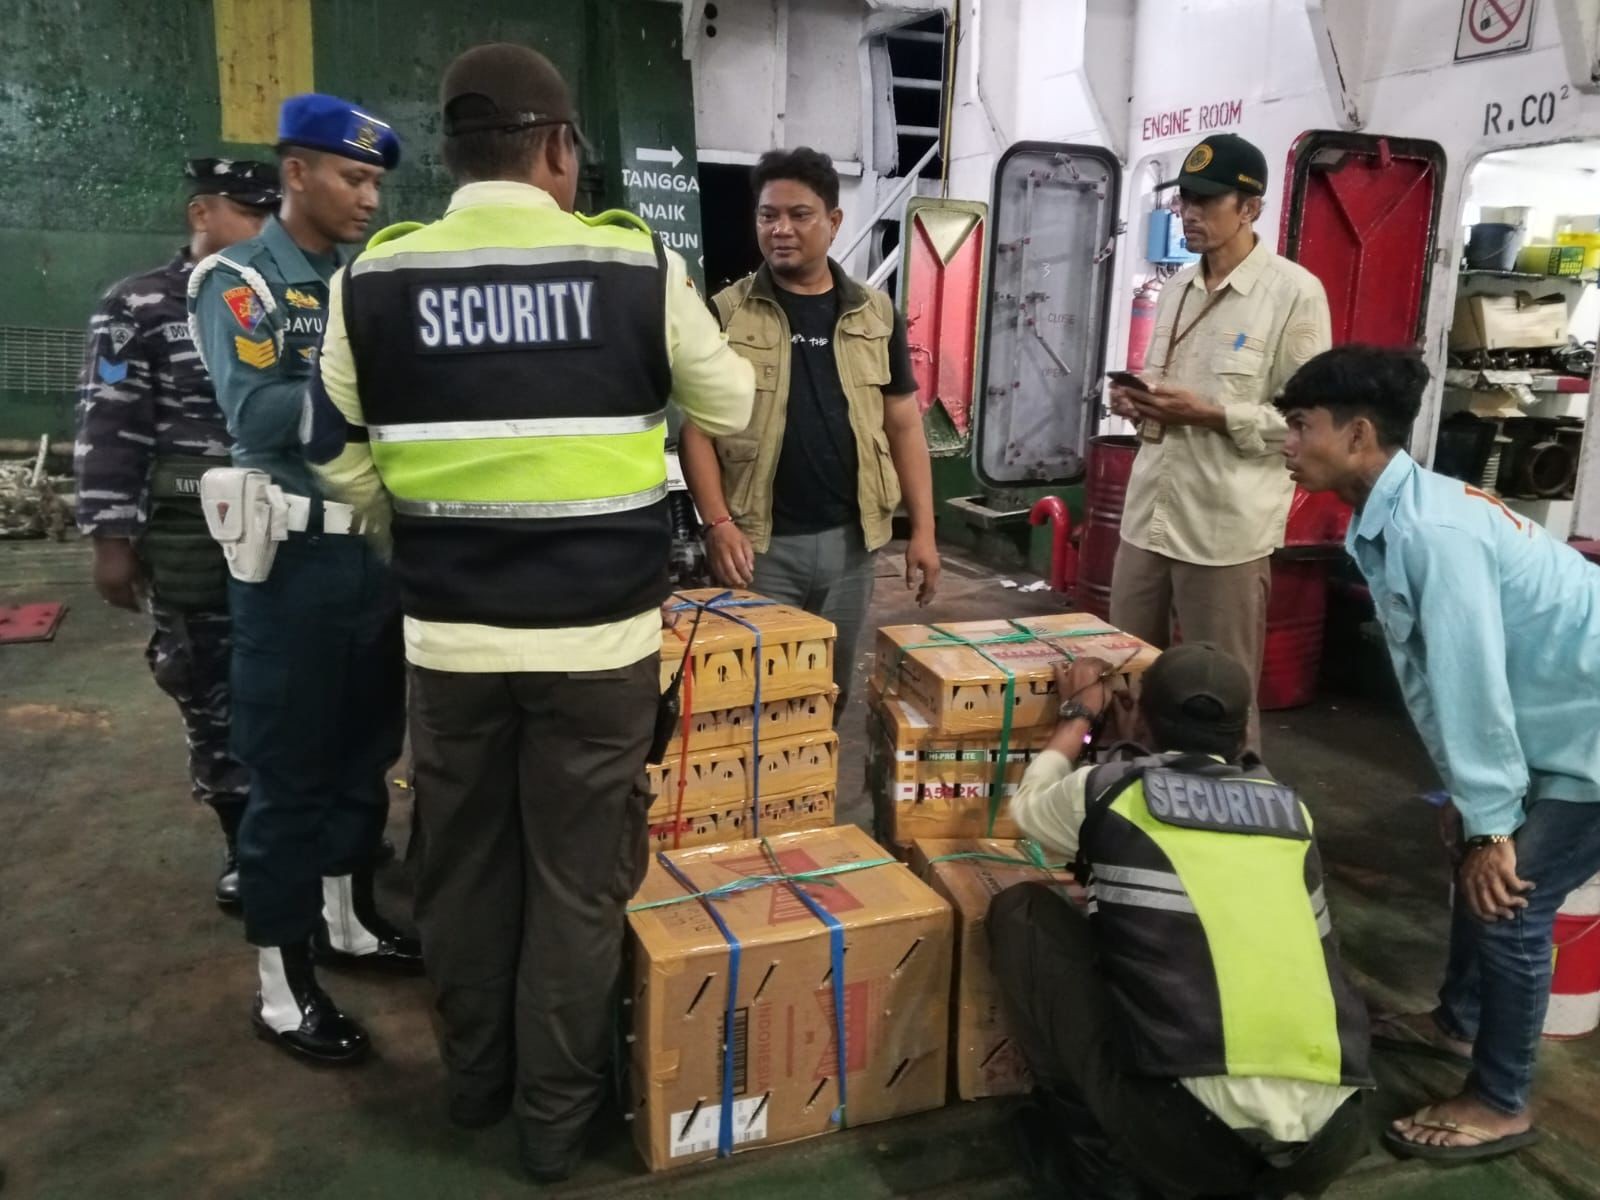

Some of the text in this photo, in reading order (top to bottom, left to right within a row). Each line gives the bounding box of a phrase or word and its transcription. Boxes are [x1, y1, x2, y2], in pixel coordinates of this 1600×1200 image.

[1142, 99, 1243, 140] ENGINE ROOM
[622, 169, 700, 192] TANGGA
[639, 202, 685, 221] NAIK
[640, 229, 698, 248] RUN
[283, 317, 323, 333] BAYU
[419, 281, 594, 346] SECURITY
[928, 752, 977, 760] HI-PROITE
[1149, 775, 1298, 831] SECURITY
[757, 1002, 772, 1093] INDONESIA
